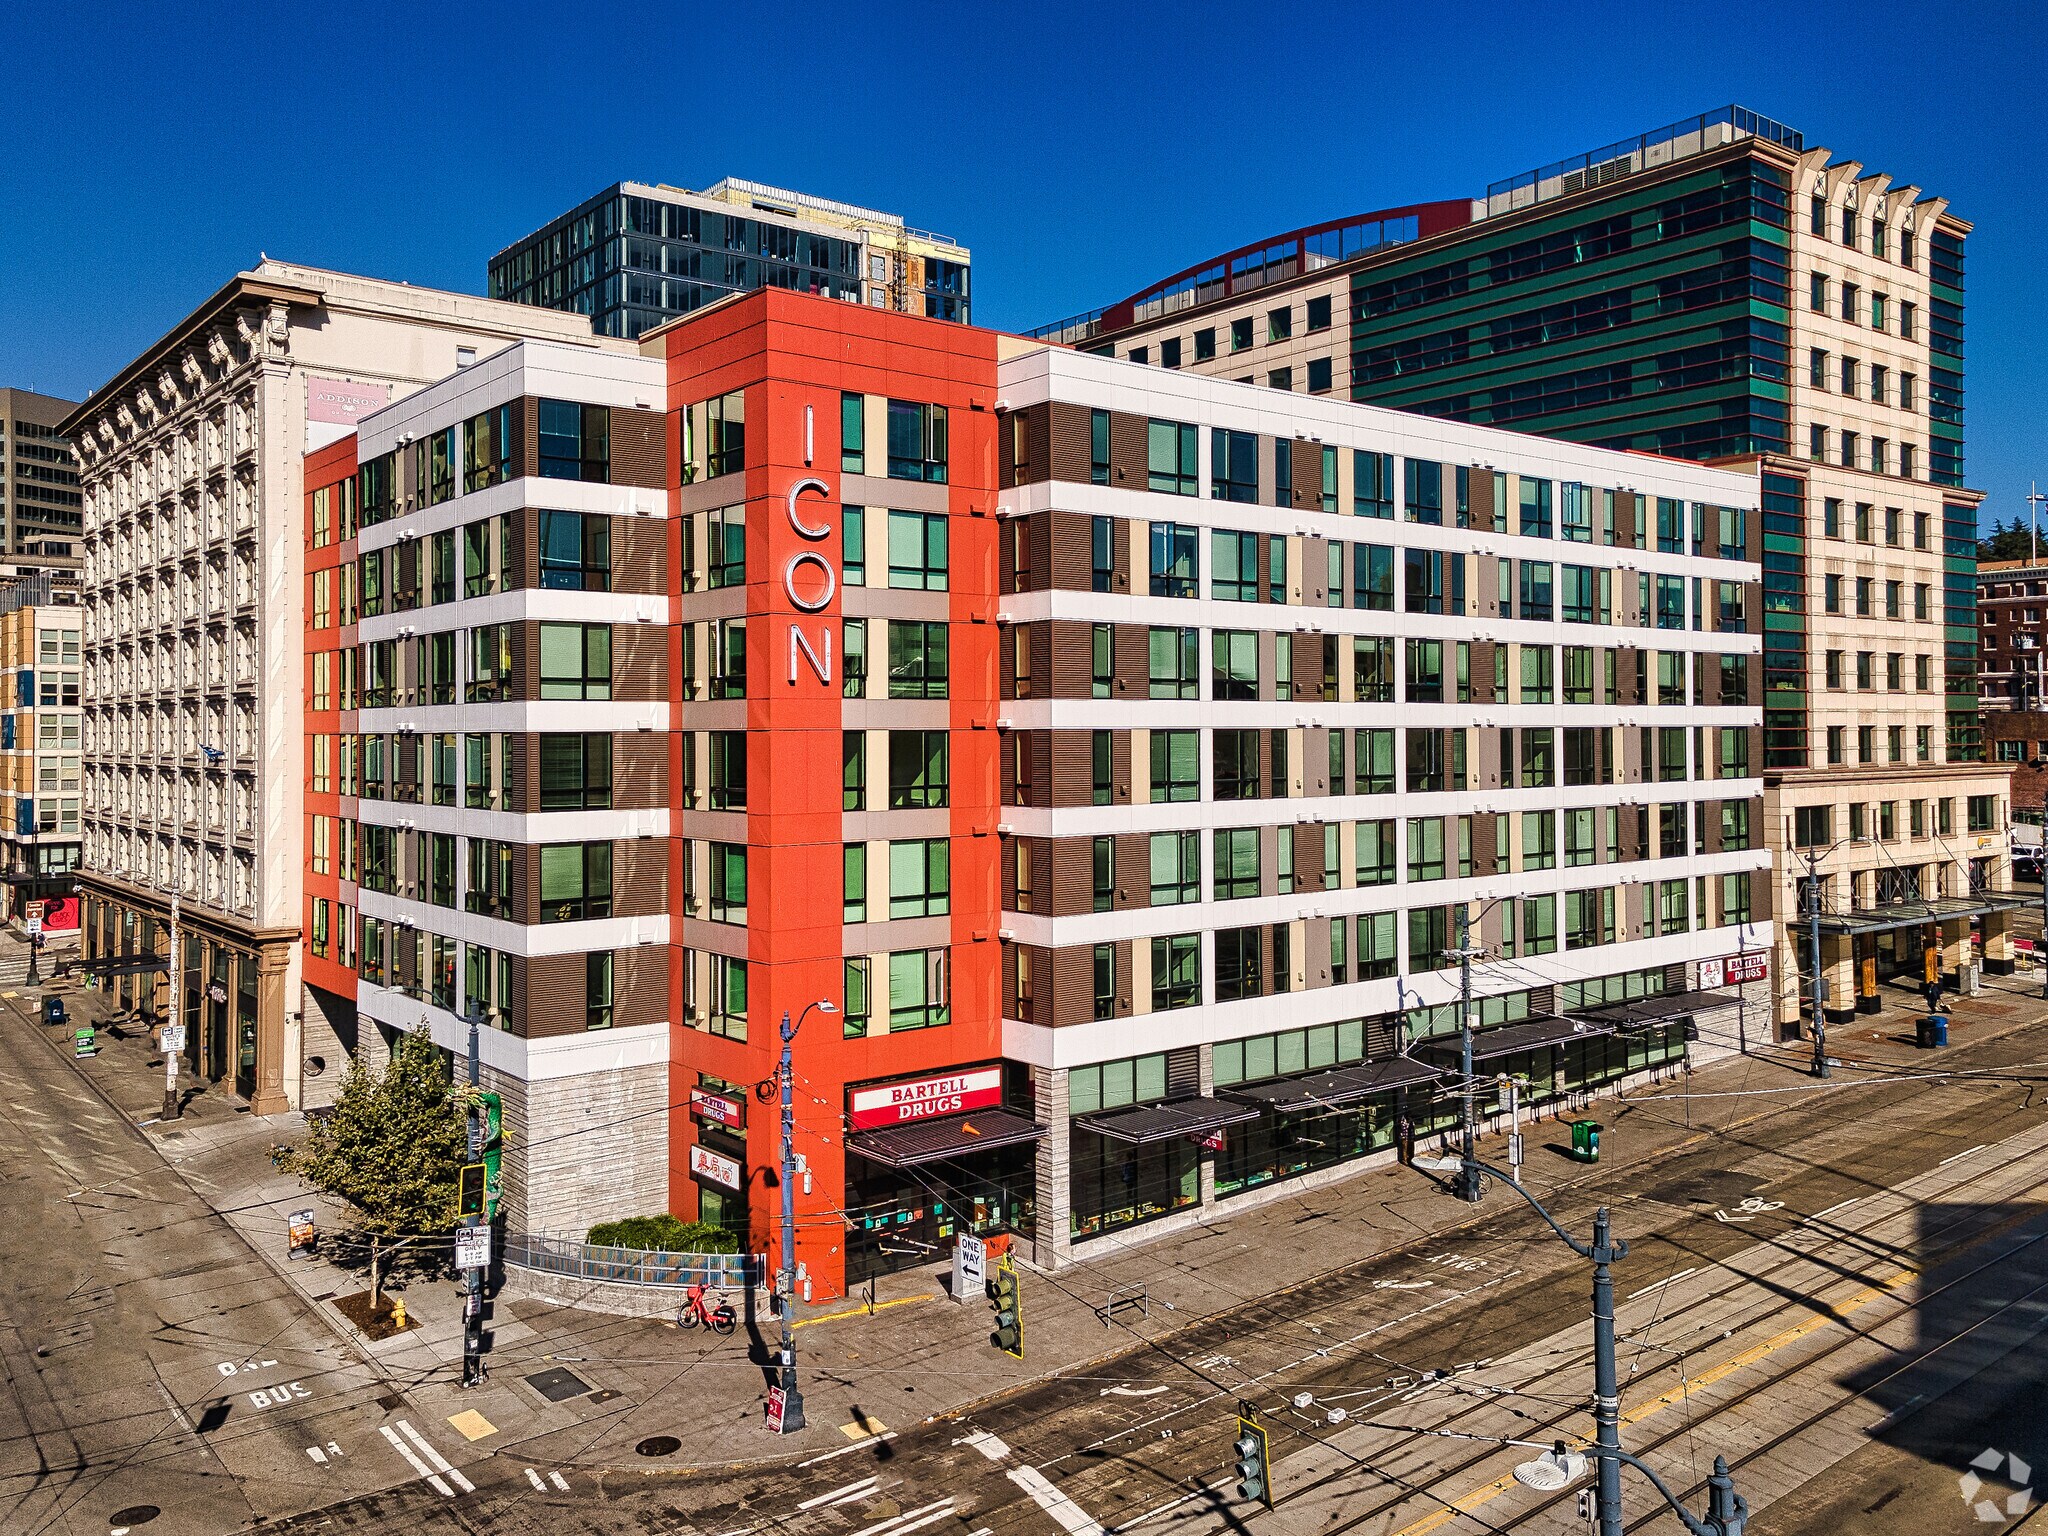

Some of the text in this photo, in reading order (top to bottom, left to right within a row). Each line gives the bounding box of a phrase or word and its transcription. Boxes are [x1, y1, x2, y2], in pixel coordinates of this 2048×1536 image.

[317, 392, 379, 407] ADDISON
[783, 404, 836, 684] ICON
[1731, 956, 1764, 970] BARTELL
[891, 1078, 968, 1103] BARTELL
[703, 1106, 725, 1121] DRUGS
[898, 1095, 962, 1120] DRUGS
[962, 1238, 980, 1254] ONE
[962, 1250, 980, 1265] WAY
[248, 1381, 313, 1409] BUS
